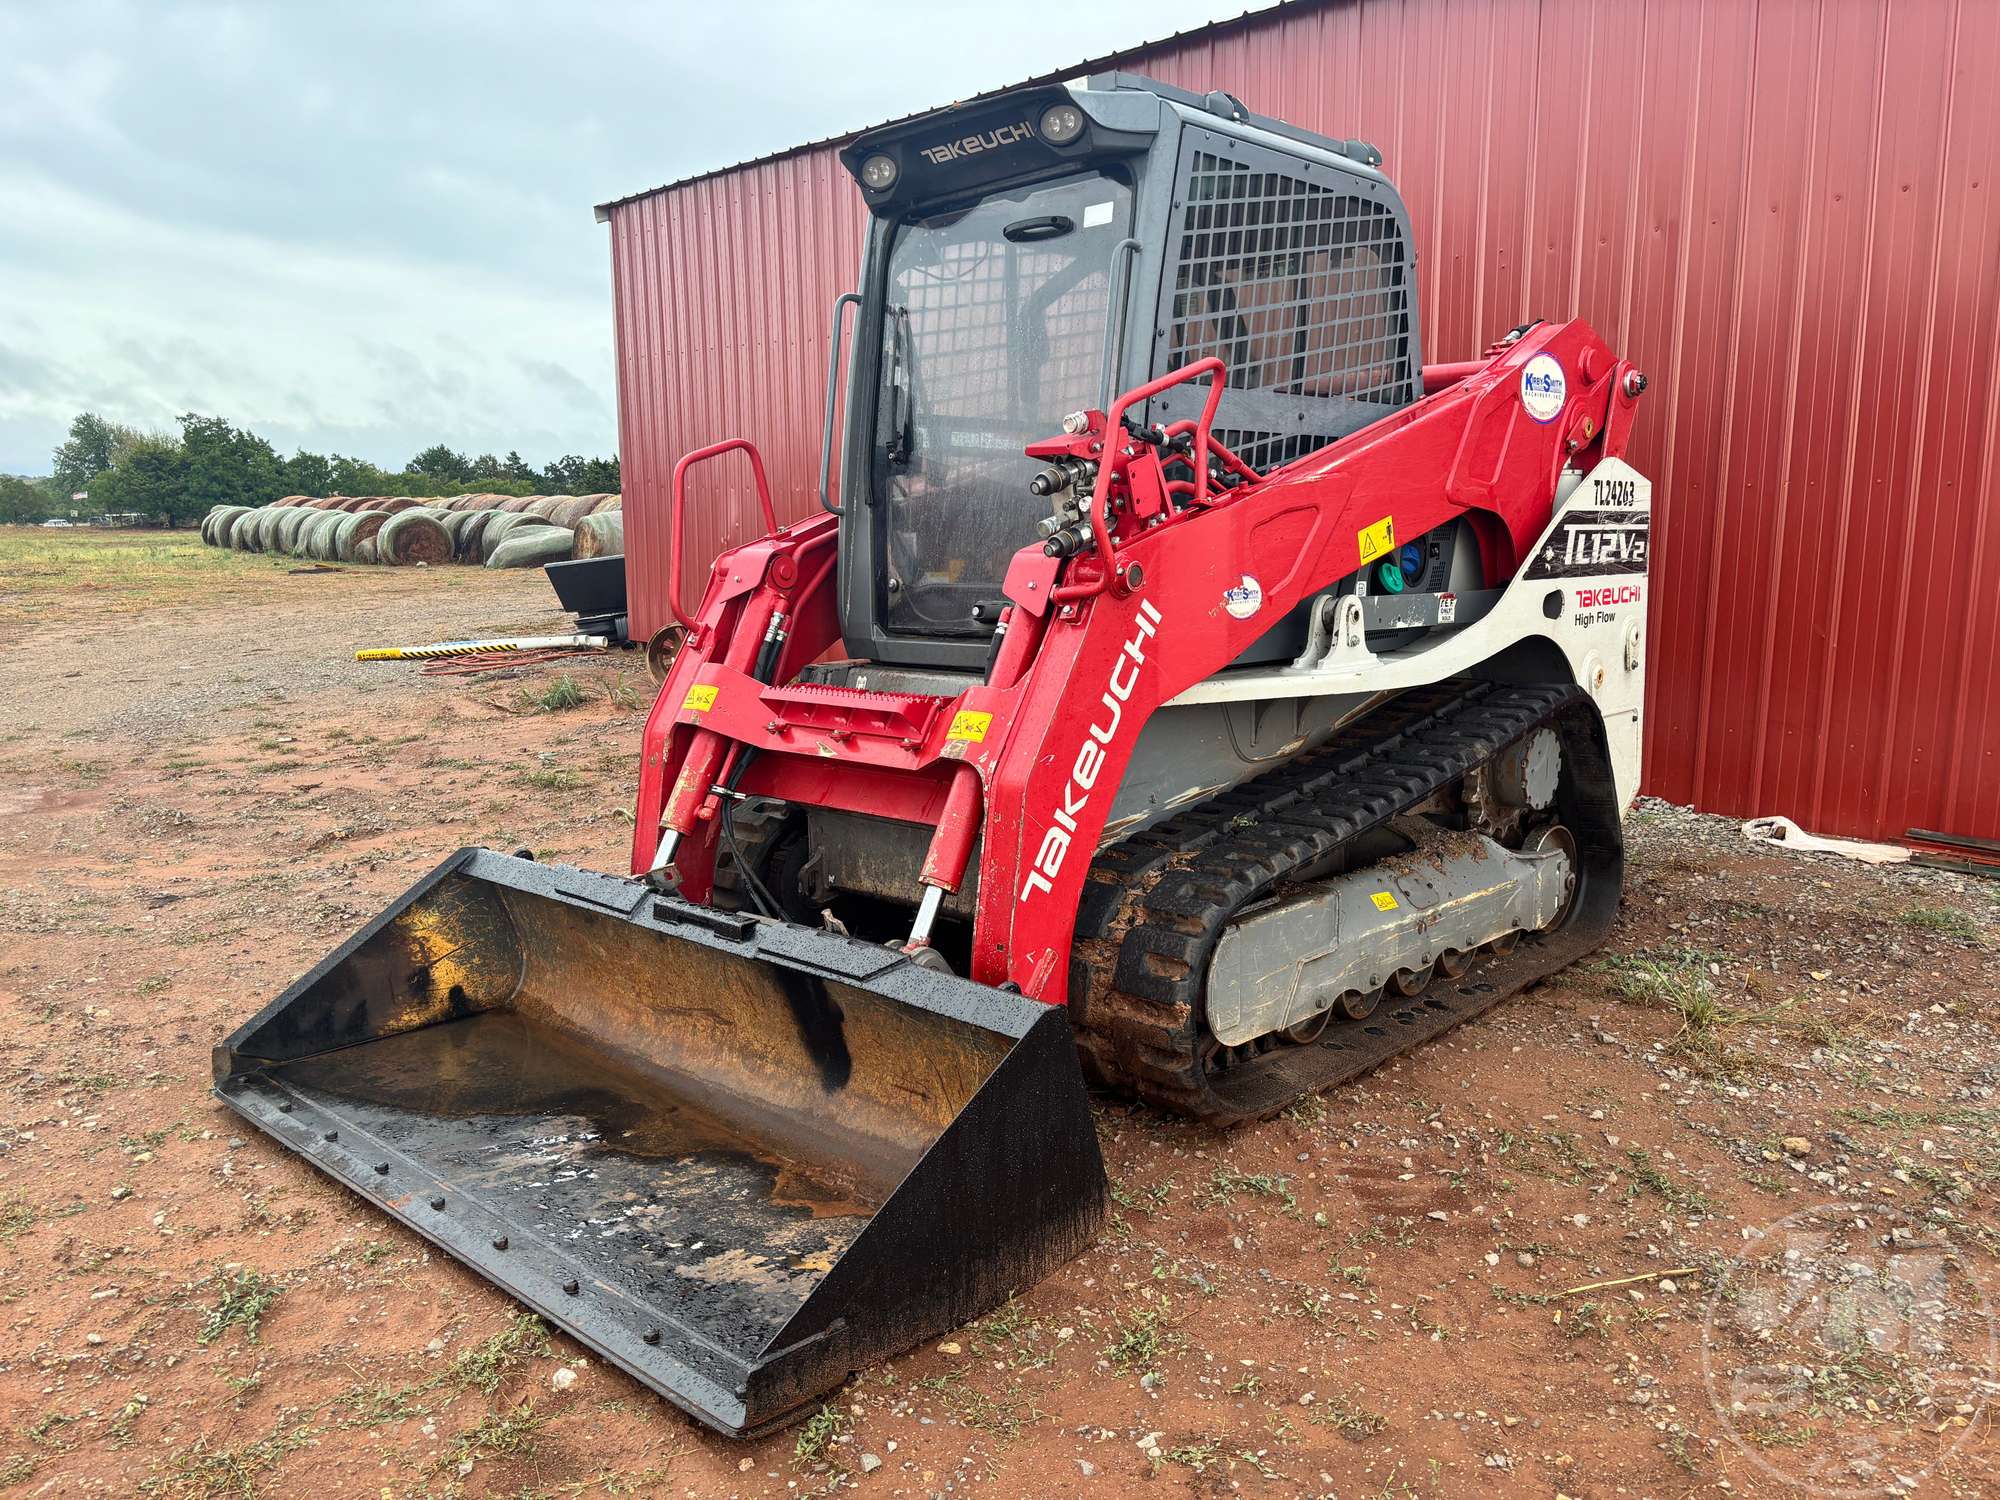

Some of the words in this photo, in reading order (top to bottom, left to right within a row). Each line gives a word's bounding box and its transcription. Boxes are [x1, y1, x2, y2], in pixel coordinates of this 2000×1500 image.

[920, 121, 1035, 164] TAKEUCHI
[1594, 480, 1635, 507] TL24263
[1576, 586, 1640, 608] TAKEUCHI
[1574, 612, 1595, 628] High
[1596, 611, 1616, 623] Flow
[1020, 598, 1162, 902] TAKEUCHI
